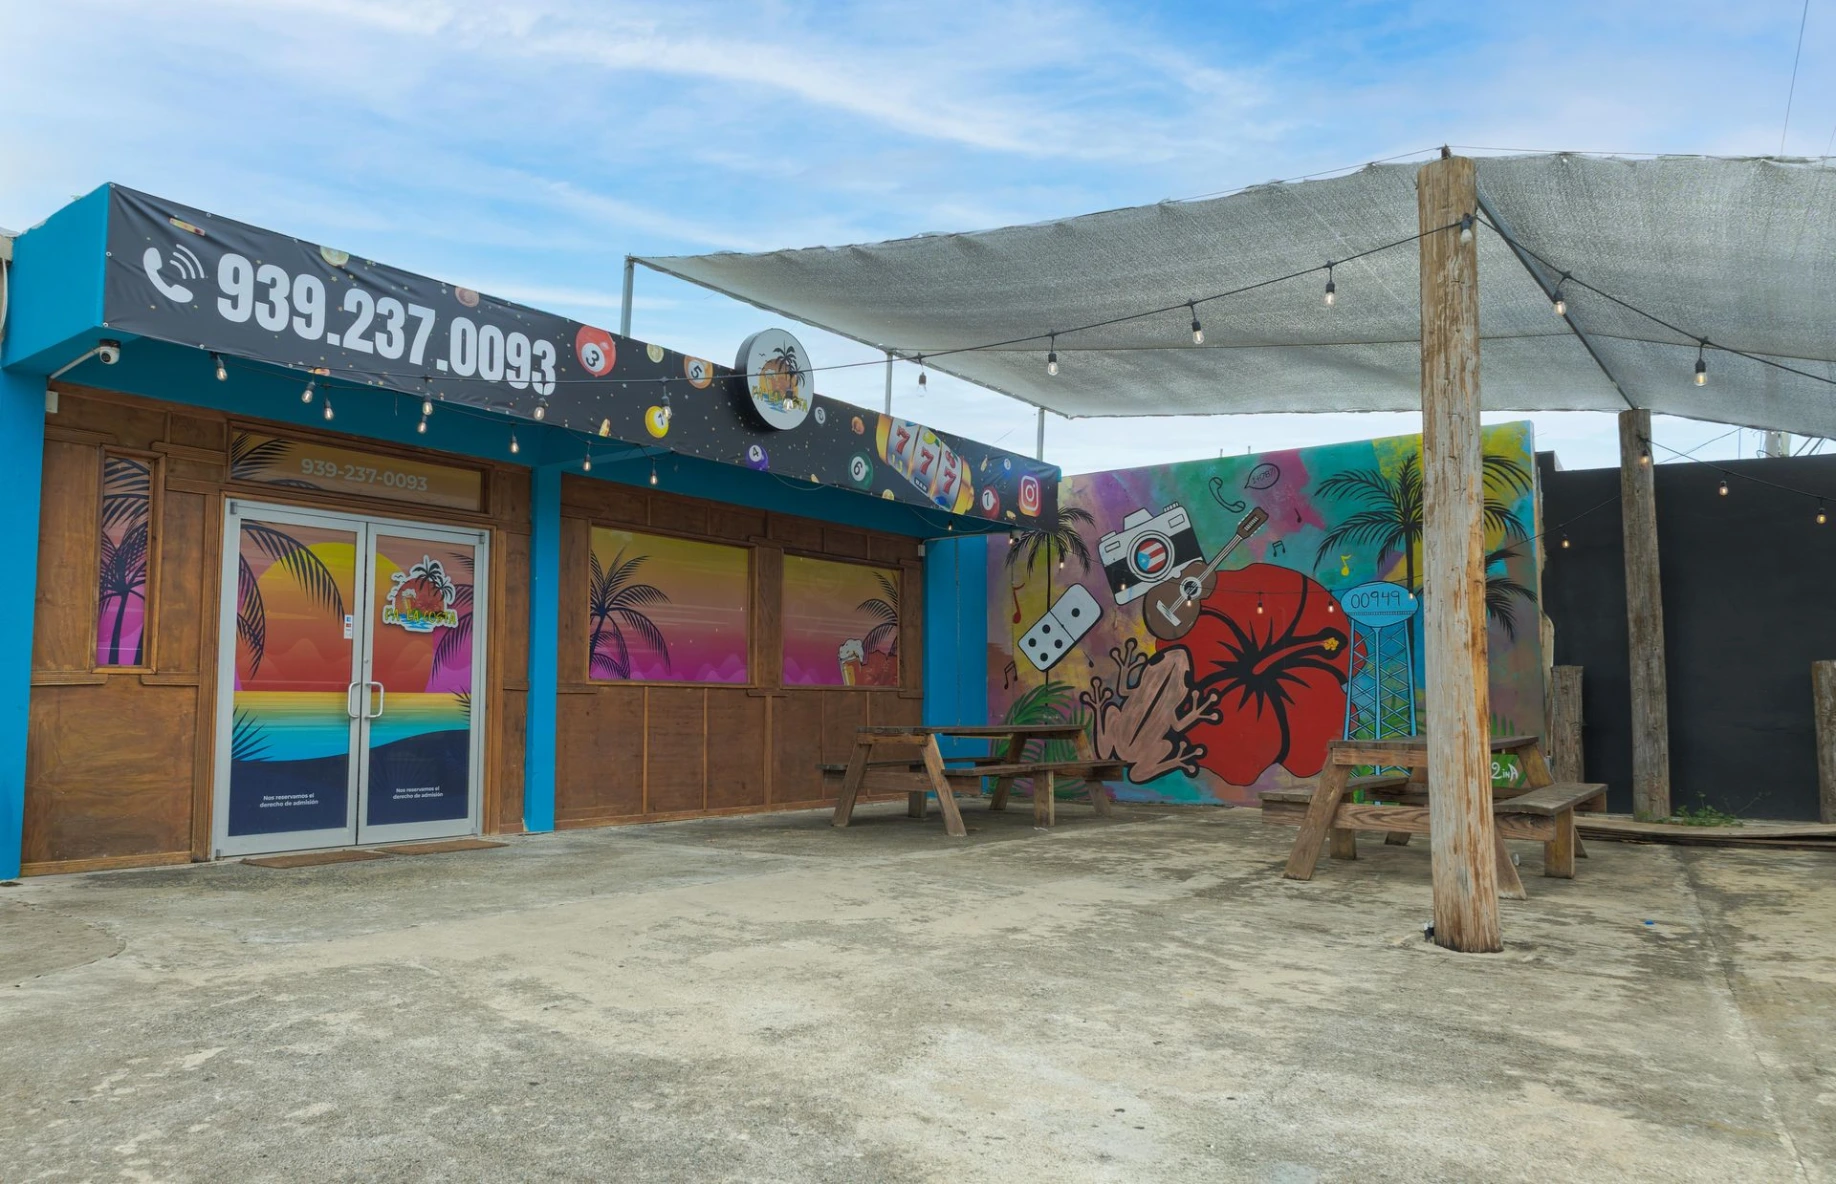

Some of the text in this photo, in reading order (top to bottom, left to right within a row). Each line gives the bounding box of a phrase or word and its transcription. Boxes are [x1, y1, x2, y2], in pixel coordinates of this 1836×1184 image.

[217, 252, 557, 396] 939.237.0093
[586, 350, 600, 367] 3
[690, 365, 702, 380] 5
[752, 447, 759, 457] 4
[301, 458, 428, 491] 939-237-0093
[854, 461, 863, 476] 6
[1351, 590, 1401, 609] 00949
[385, 608, 457, 625] PA LA COSTA
[293, 798, 319, 806] admisión
